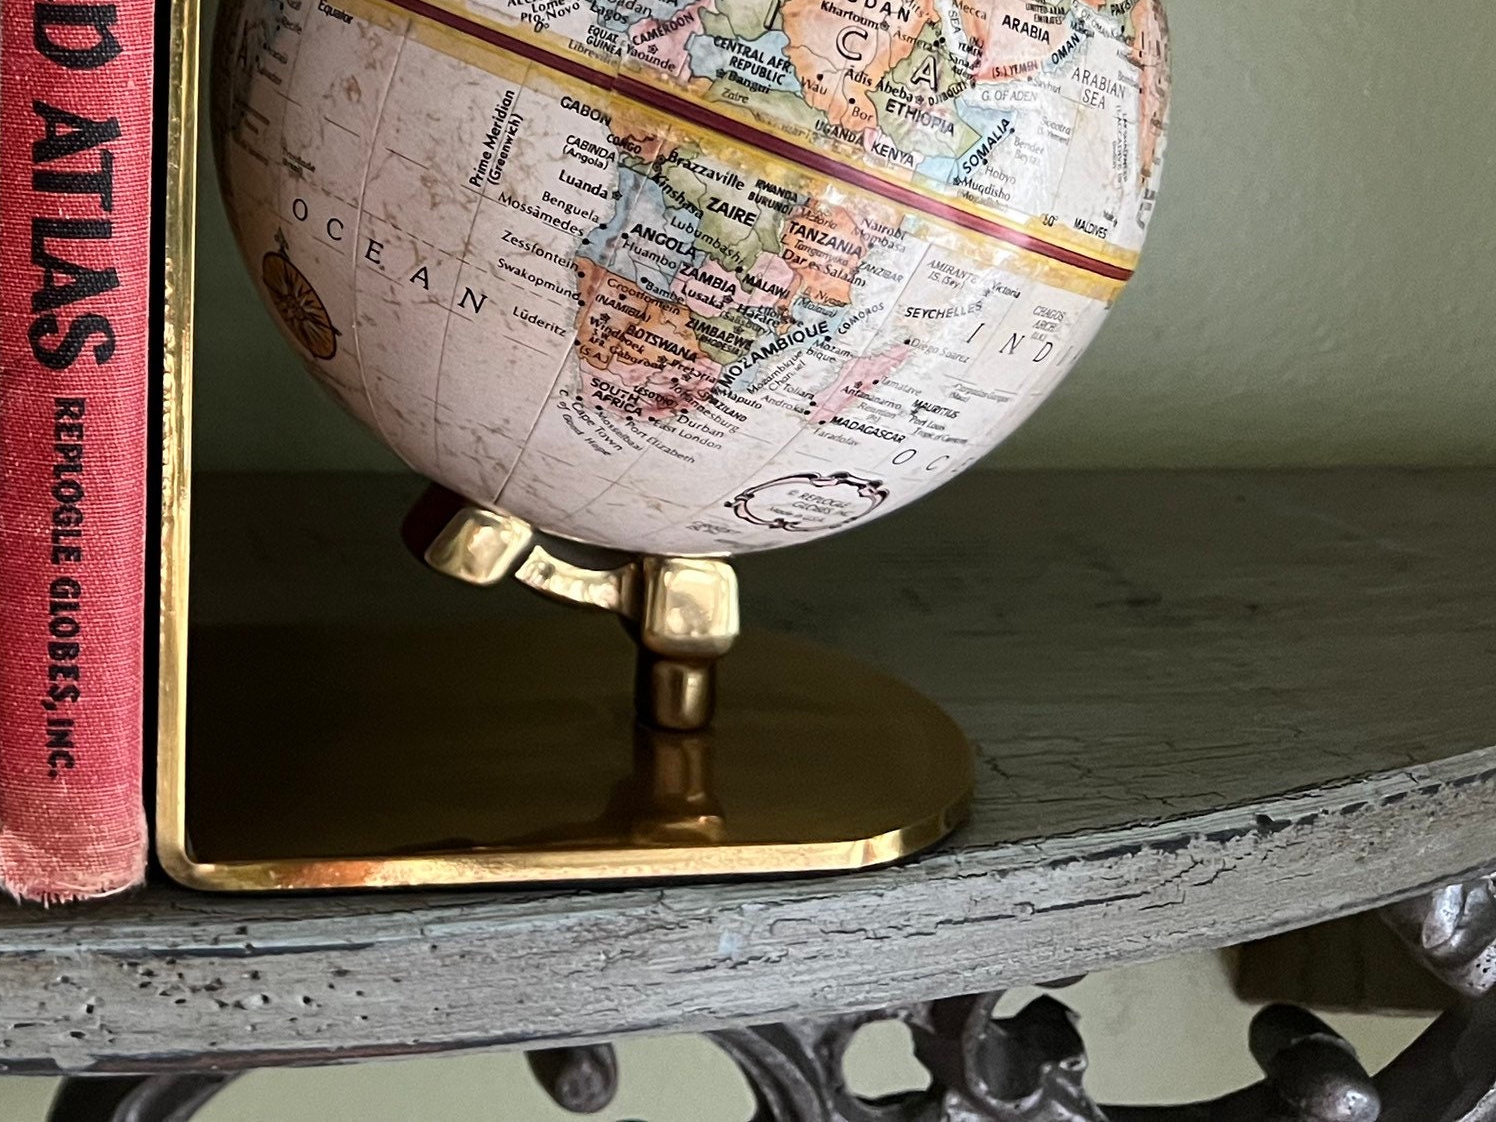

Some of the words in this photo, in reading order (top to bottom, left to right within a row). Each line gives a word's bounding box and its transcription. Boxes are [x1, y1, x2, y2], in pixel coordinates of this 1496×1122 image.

[588, 1, 629, 26] Lagos
[630, 12, 696, 47] CAMEROON
[820, 0, 881, 31] Khartoum
[1000, 13, 1052, 46] ARABIA
[712, 35, 764, 66] CENTRAL
[1051, 32, 1081, 66] OMAN
[728, 55, 786, 87] REPUBLIC
[1070, 64, 1127, 100] ARABIAN
[559, 95, 614, 128] GABON
[1081, 88, 1107, 110] SEA
[813, 118, 866, 148] UGANDA
[884, 97, 955, 138] ETHIOPIA
[468, 152, 492, 188] Prime
[481, 89, 516, 155] Meridian
[487, 112, 524, 187] (Greenwich)
[565, 133, 617, 164] CABINDA
[870, 139, 915, 169] KENYA
[961, 116, 1012, 175] SOMALIA
[562, 144, 610, 172] (Angola)
[665, 147, 746, 193] Brazzaville
[558, 168, 609, 201] Luanda
[540, 189, 601, 225] Benguela
[705, 195, 758, 228] ZAIRE
[26, 98, 122, 371] ATLAS
[500, 228, 581, 273] Zessfontein
[629, 222, 699, 260] ANGOLA
[669, 214, 745, 266] Lubumbashi
[788, 220, 865, 260] TANZANIA
[291, 197, 489, 315] OCEAN
[497, 257, 582, 302] Swakopmund
[679, 261, 738, 297] ZAMBIA
[680, 283, 726, 311] Lusaka
[903, 299, 983, 320] SEYCHELLES
[625, 323, 700, 364] BOTSWANA
[720, 320, 830, 390] MOZAMBIQUE
[590, 376, 641, 405] SOUTH
[592, 389, 645, 418] AFRICA
[675, 413, 726, 440] Durban
[829, 415, 907, 445] MADAGASCAR
[52, 396, 86, 566] REPLOGLE
[40, 577, 85, 714] GLOBES,
[46, 718, 76, 778] INC.
